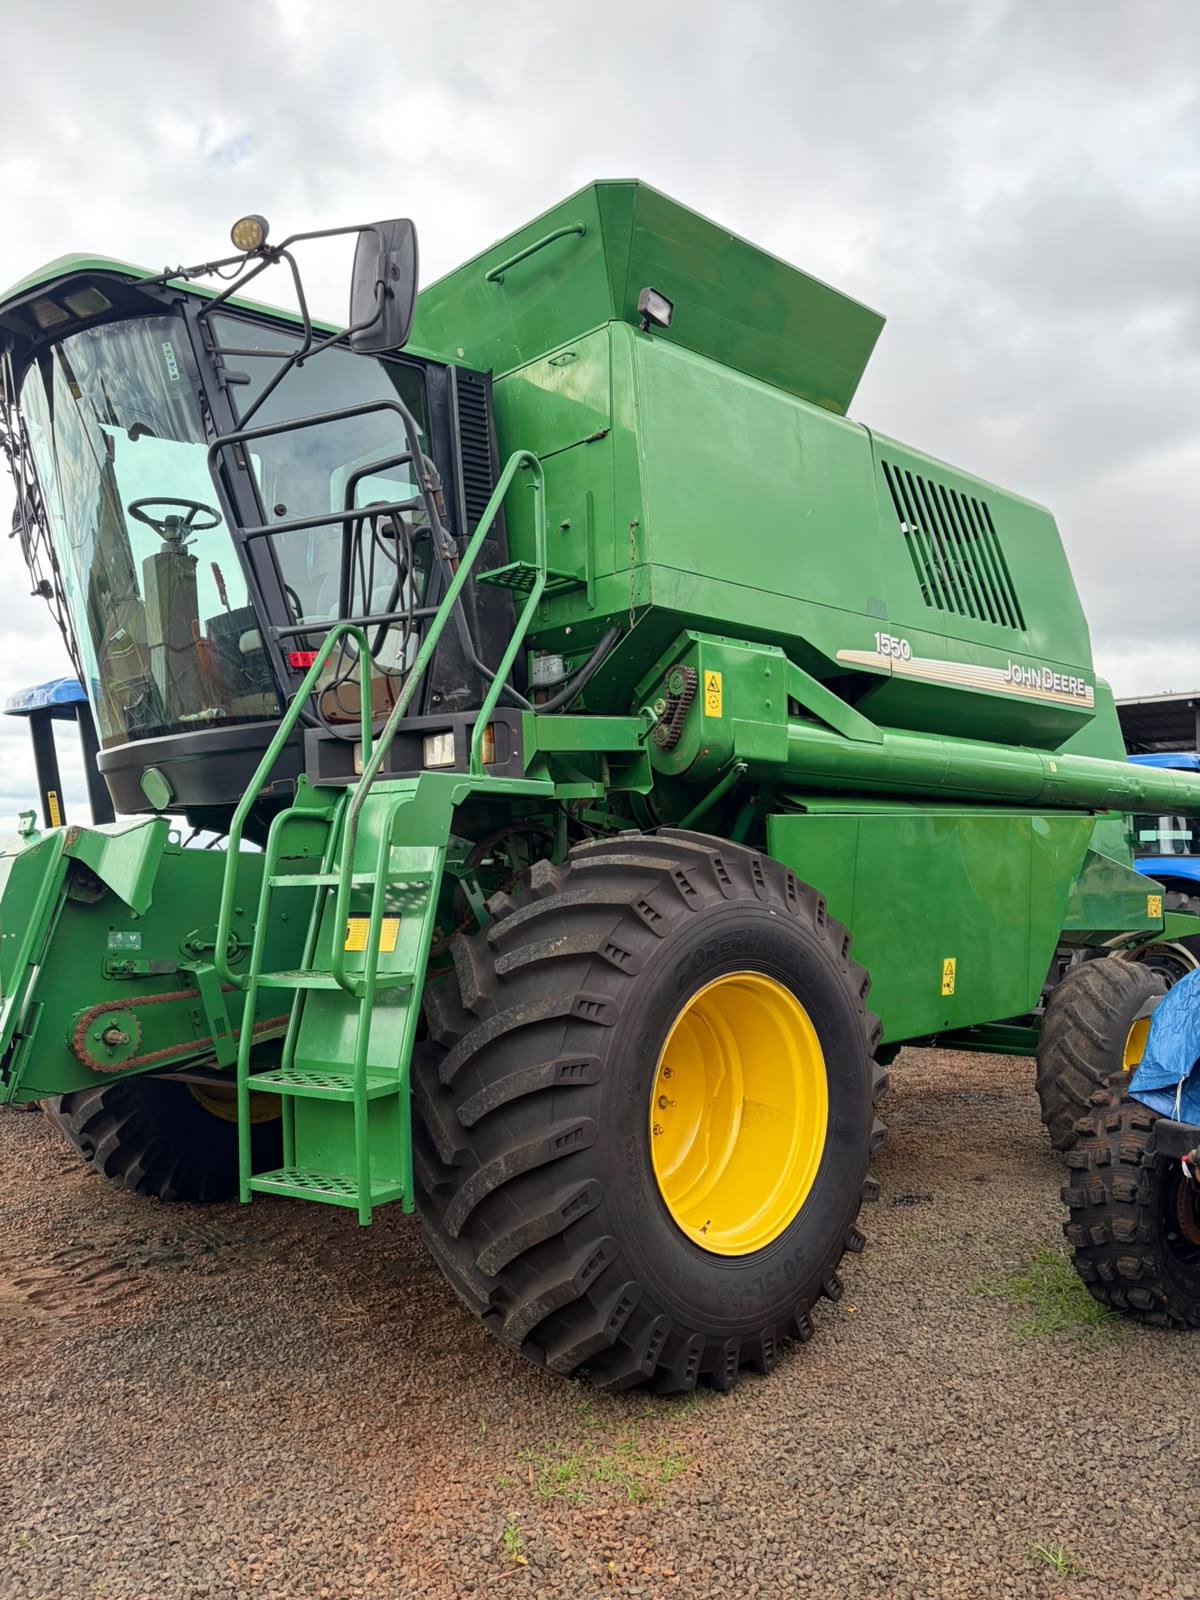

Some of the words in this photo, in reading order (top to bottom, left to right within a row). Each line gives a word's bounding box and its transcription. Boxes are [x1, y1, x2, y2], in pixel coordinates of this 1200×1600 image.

[874, 631, 911, 660] 1550
[1004, 659, 1041, 687] JOHN
[1041, 666, 1086, 696] DEERE
